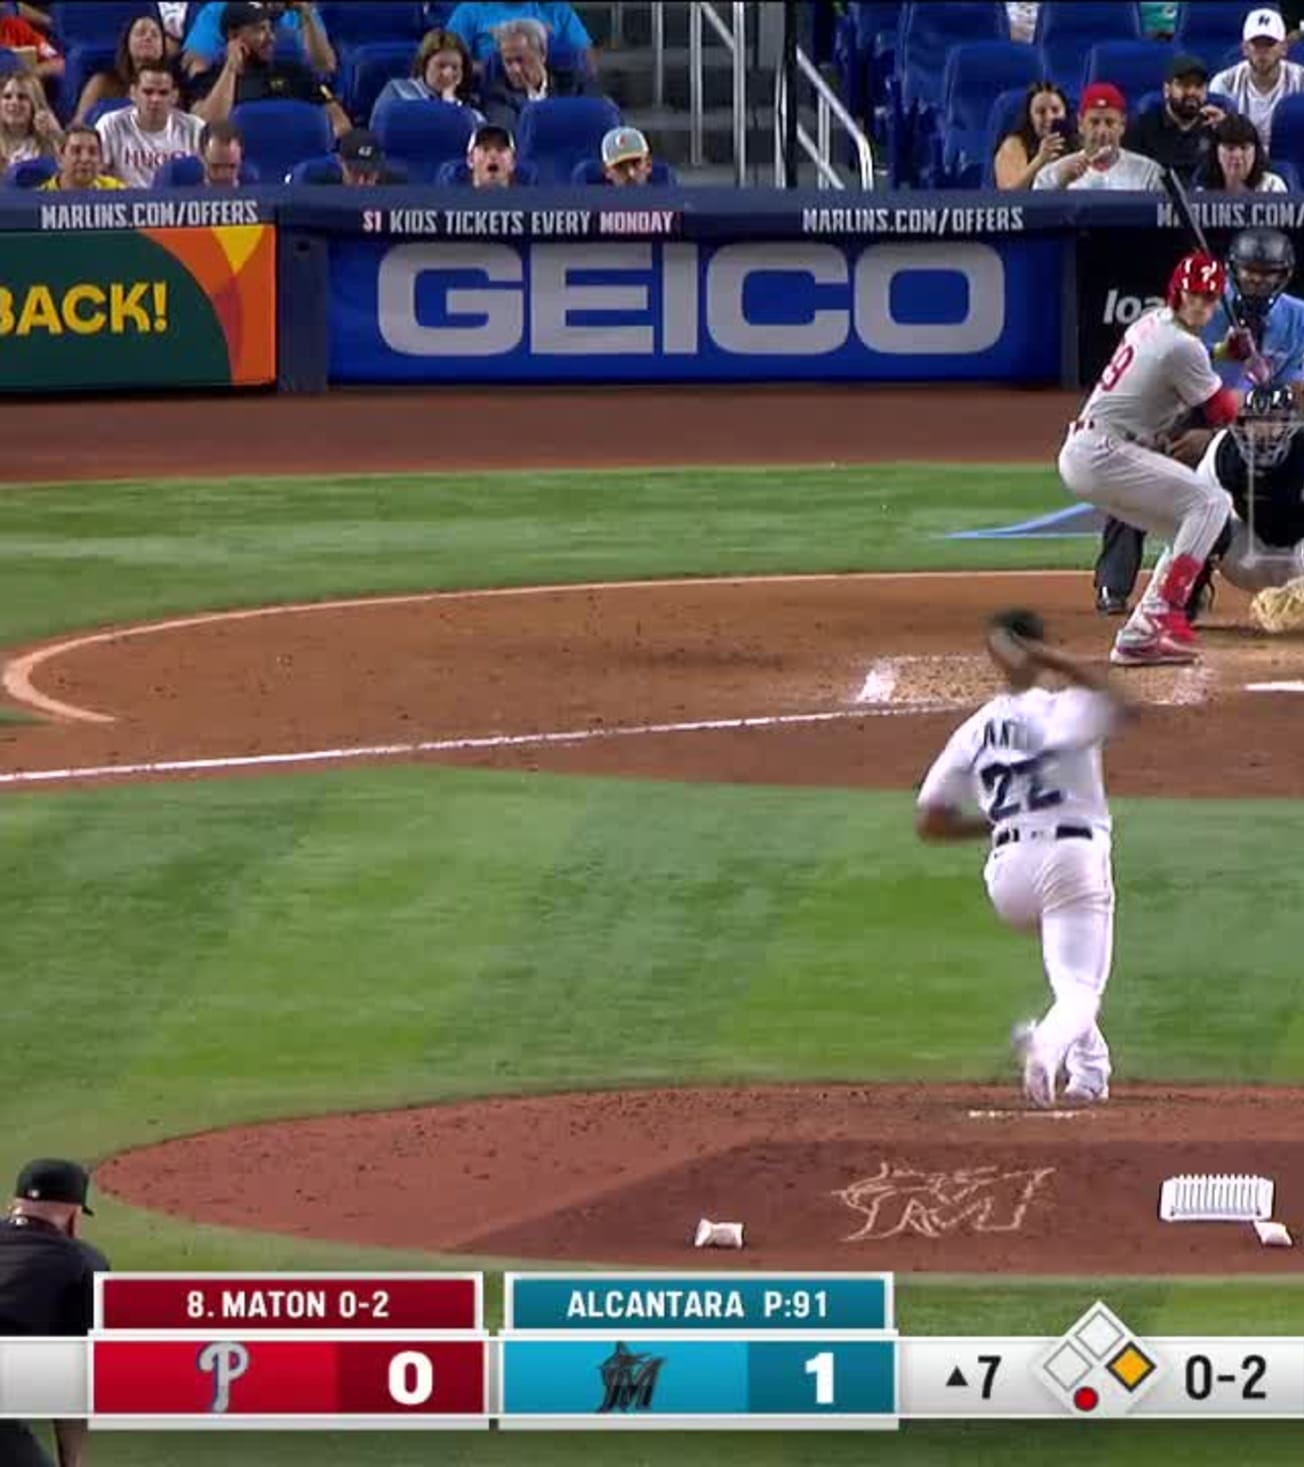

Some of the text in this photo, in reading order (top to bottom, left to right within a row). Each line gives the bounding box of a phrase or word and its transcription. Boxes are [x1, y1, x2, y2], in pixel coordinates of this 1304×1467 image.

[41, 200, 258, 229] MARLINS.COM/OFFERS
[389, 210, 437, 233] KIDS
[444, 210, 524, 234] TICKETS
[531, 210, 591, 234] EVERY
[600, 210, 674, 233] MONDAY
[802, 206, 1024, 235] MARLINS.COM/OFFERS
[377, 241, 1006, 357] GEICO
